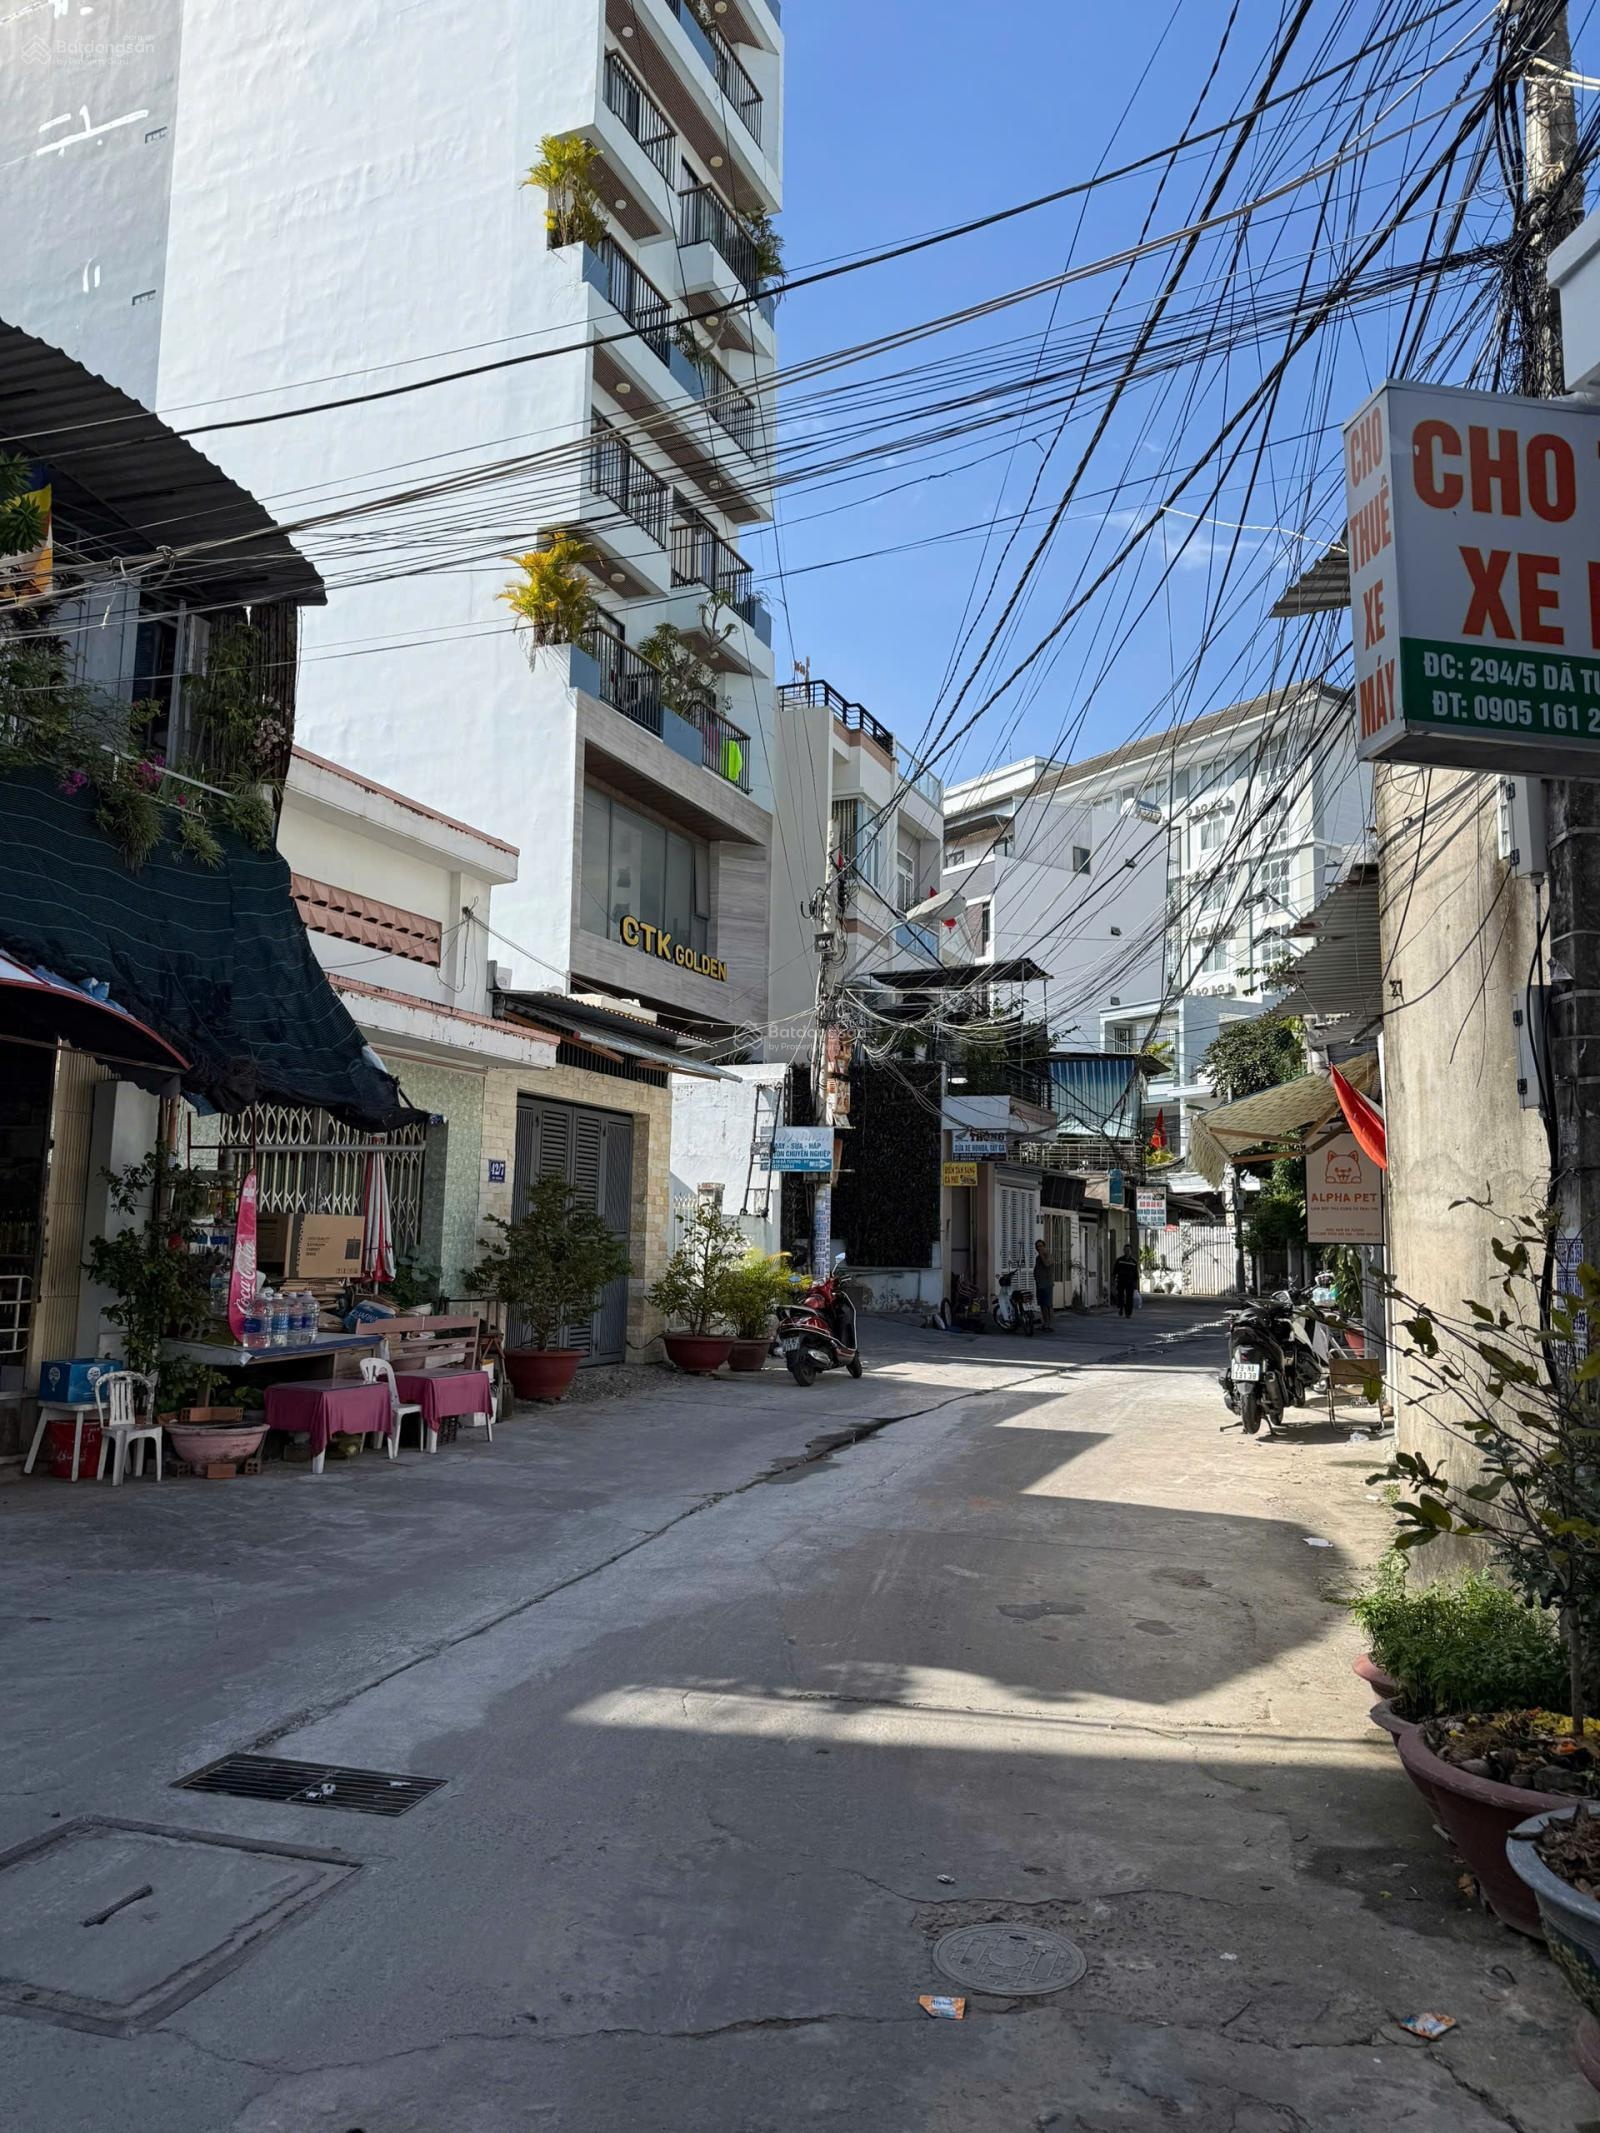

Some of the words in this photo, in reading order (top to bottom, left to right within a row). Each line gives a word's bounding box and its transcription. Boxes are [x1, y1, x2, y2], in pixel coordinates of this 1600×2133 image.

[1351, 406, 1382, 488] CHO
[1412, 419, 1577, 523] CHO
[1350, 474, 1392, 573] THUÊ
[1362, 578, 1386, 651] XE
[1458, 545, 1564, 646] XE
[1360, 655, 1396, 740] MÁY
[1423, 651, 1465, 681] ĐC:
[1470, 657, 1537, 689] 294/5
[1543, 662, 1576, 693] DÃ
[1432, 690, 1468, 719] ĐT:
[1474, 695, 1533, 726] 0905
[1539, 702, 1580, 731] 161
[620, 914, 673, 961] CTK
[674, 943, 729, 983] GOLDEN
[1311, 1192, 1351, 1203] ALPHA
[1354, 1193, 1377, 1203] PET
